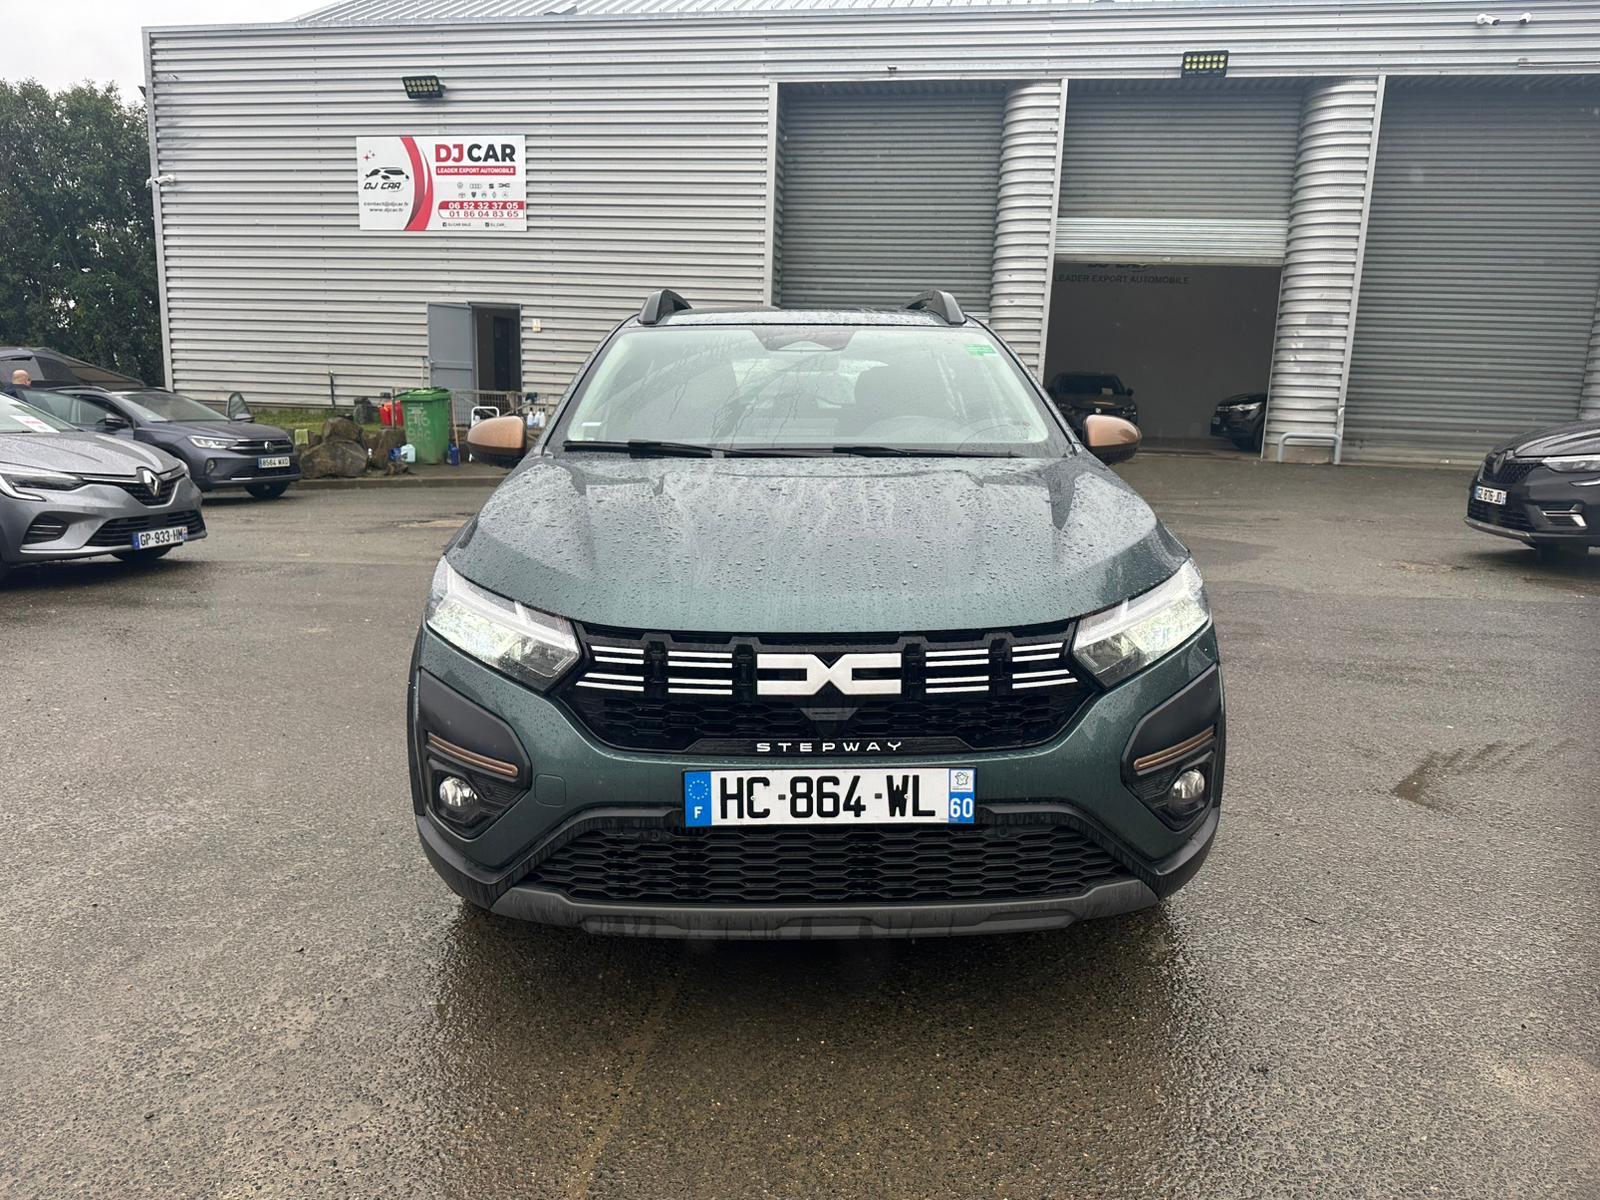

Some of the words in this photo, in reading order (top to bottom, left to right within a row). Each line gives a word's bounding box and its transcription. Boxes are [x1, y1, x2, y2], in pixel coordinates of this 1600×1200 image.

[435, 144, 463, 162] DJ
[467, 143, 515, 162] CAR
[363, 182, 378, 190] DJ
[380, 182, 401, 190] CAR
[1054, 274, 1089, 282] LEADER
[1091, 275, 1128, 283] EXPORT
[1128, 275, 1189, 285] AUTOMOBILE
[756, 741, 903, 753] STEPWAY
[694, 806, 703, 819] F
[950, 798, 974, 818] 60
